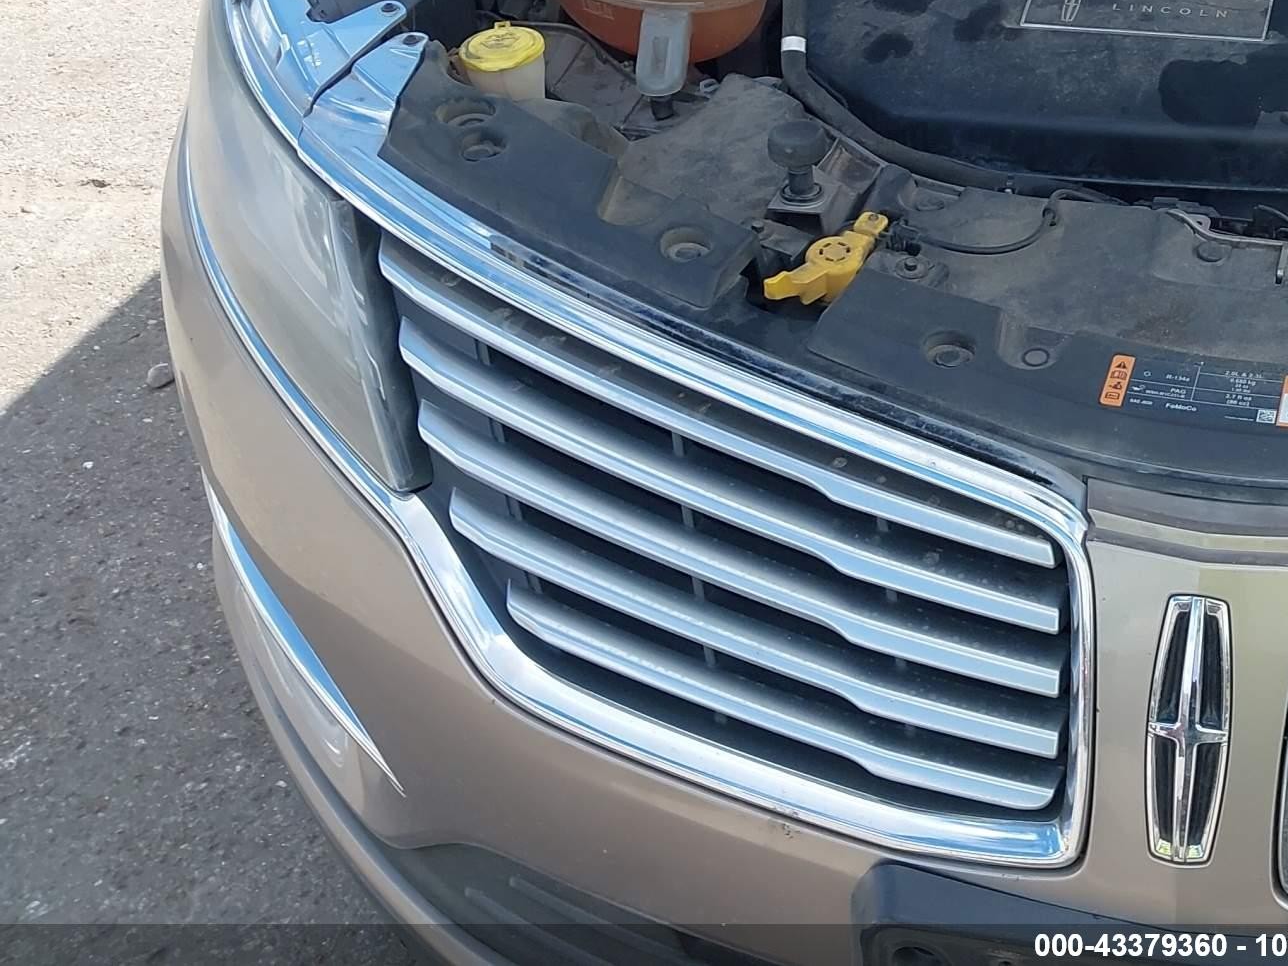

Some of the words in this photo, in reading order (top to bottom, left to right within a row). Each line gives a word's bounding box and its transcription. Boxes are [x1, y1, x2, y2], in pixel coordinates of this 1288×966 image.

[1112, 3, 1228, 18] LINCOLN
[1170, 387, 1187, 395] PAG
[1165, 402, 1197, 412] FoMoCo
